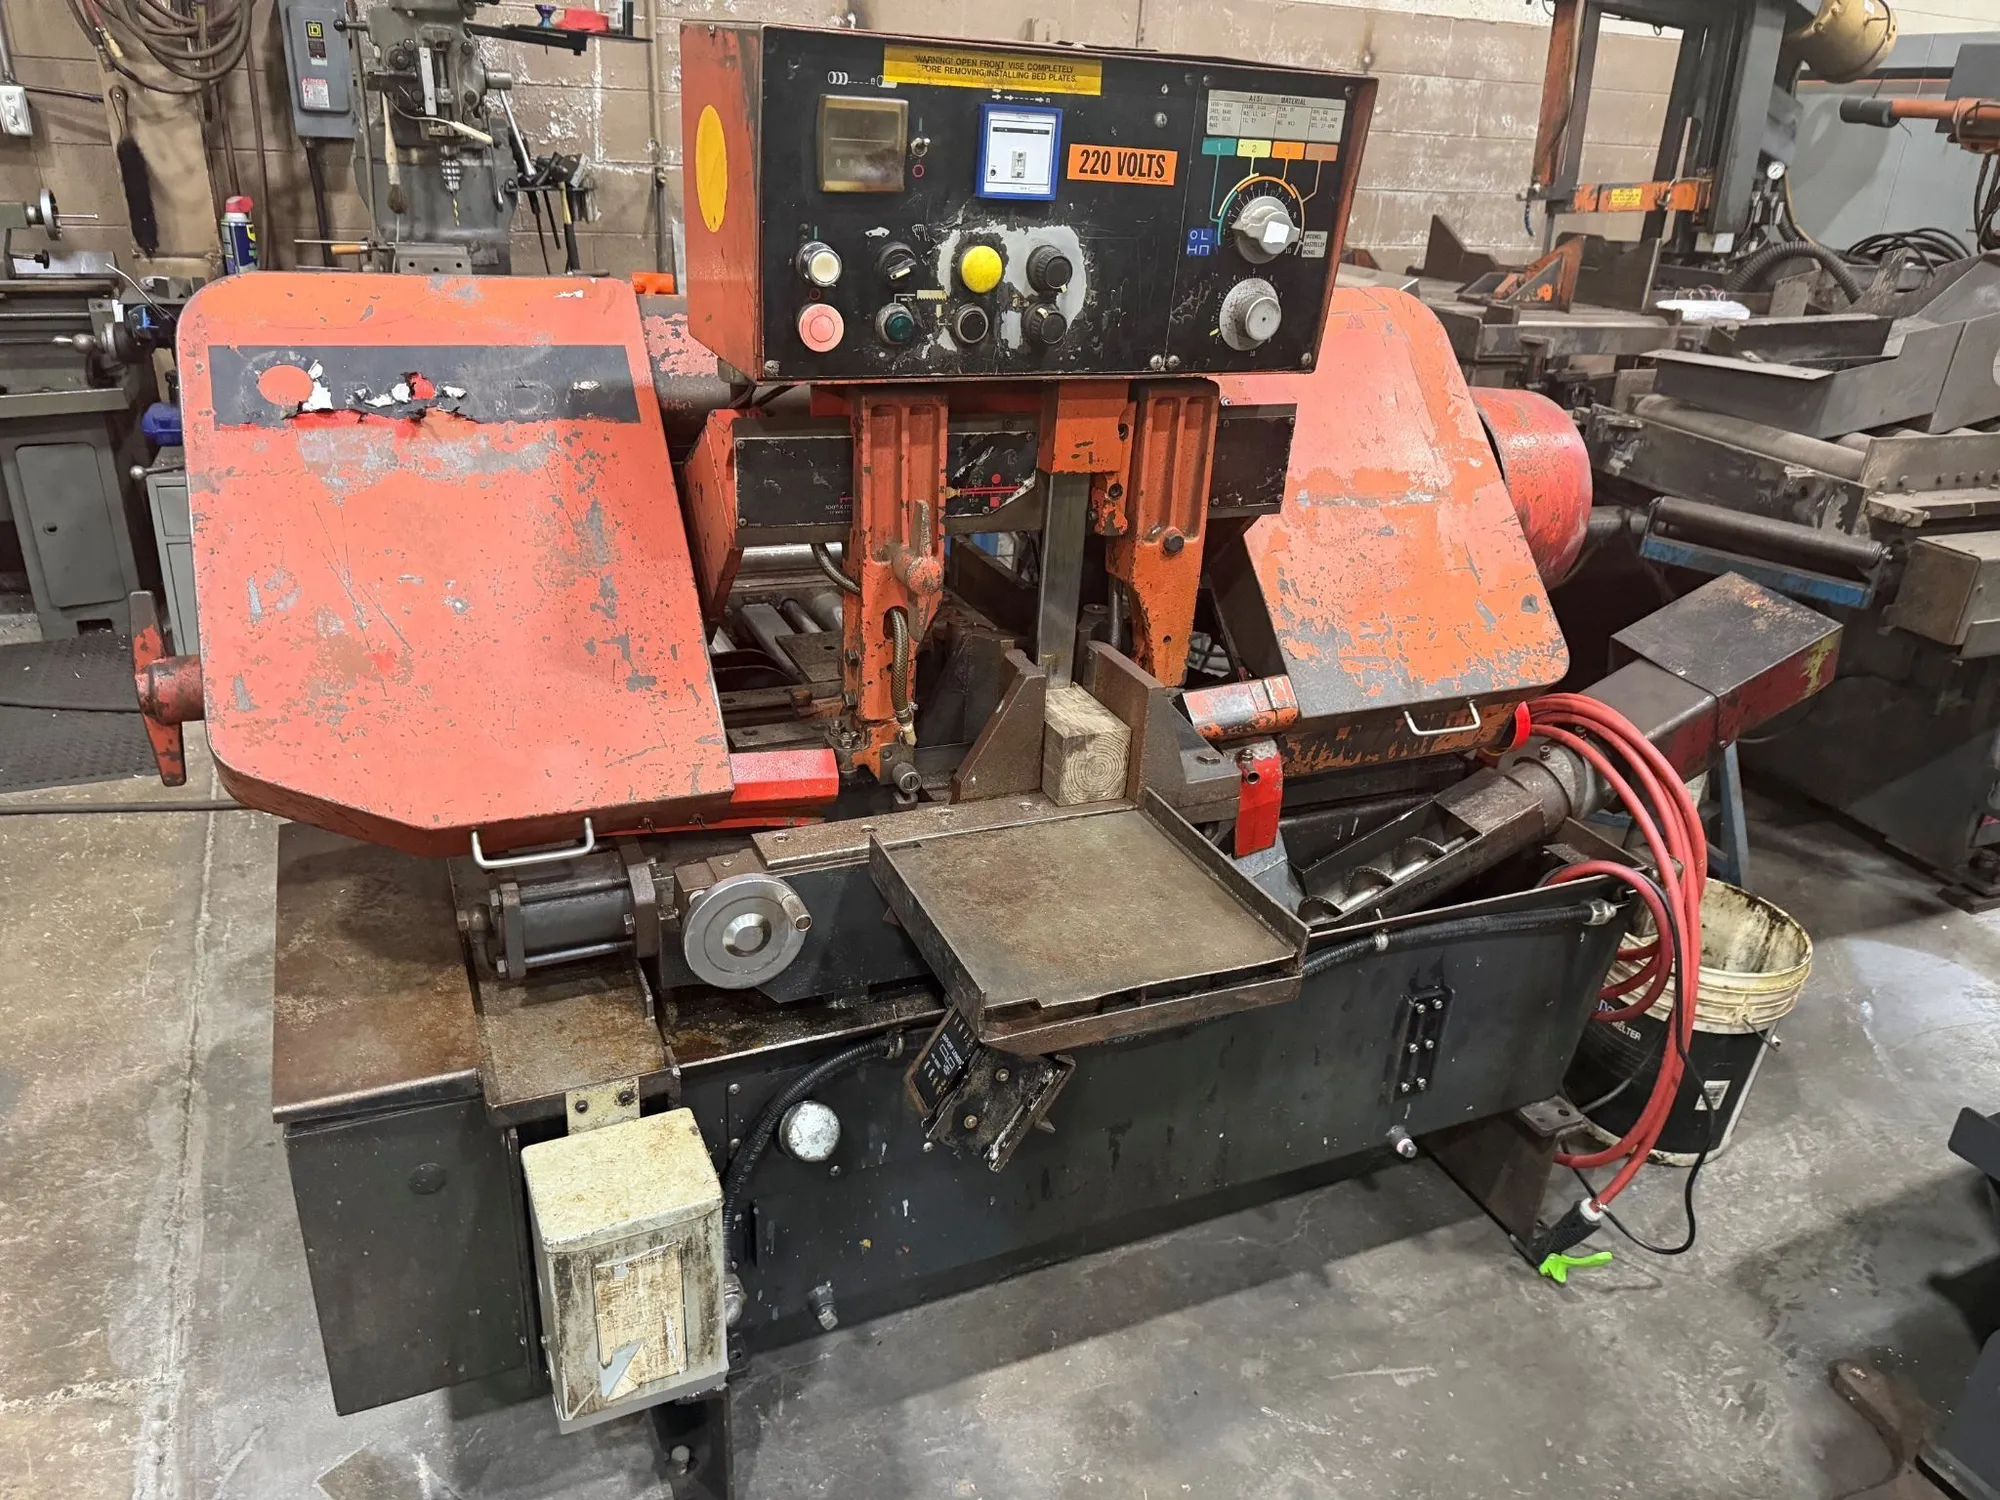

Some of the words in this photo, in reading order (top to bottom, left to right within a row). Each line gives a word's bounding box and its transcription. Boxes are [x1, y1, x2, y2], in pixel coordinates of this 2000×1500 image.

[915, 54, 953, 65] WARNING!
[956, 57, 978, 67] OPEN
[980, 59, 1004, 70] FRONT
[1009, 61, 1025, 71] VISE
[1027, 63, 1074, 74] COMPLETELY
[1032, 72, 1047, 81] BED
[1280, 96, 1307, 106] MATERIAL
[1251, 144, 1257, 153] 2
[1078, 148, 1112, 176] 220
[1117, 151, 1166, 179] VOLTS
